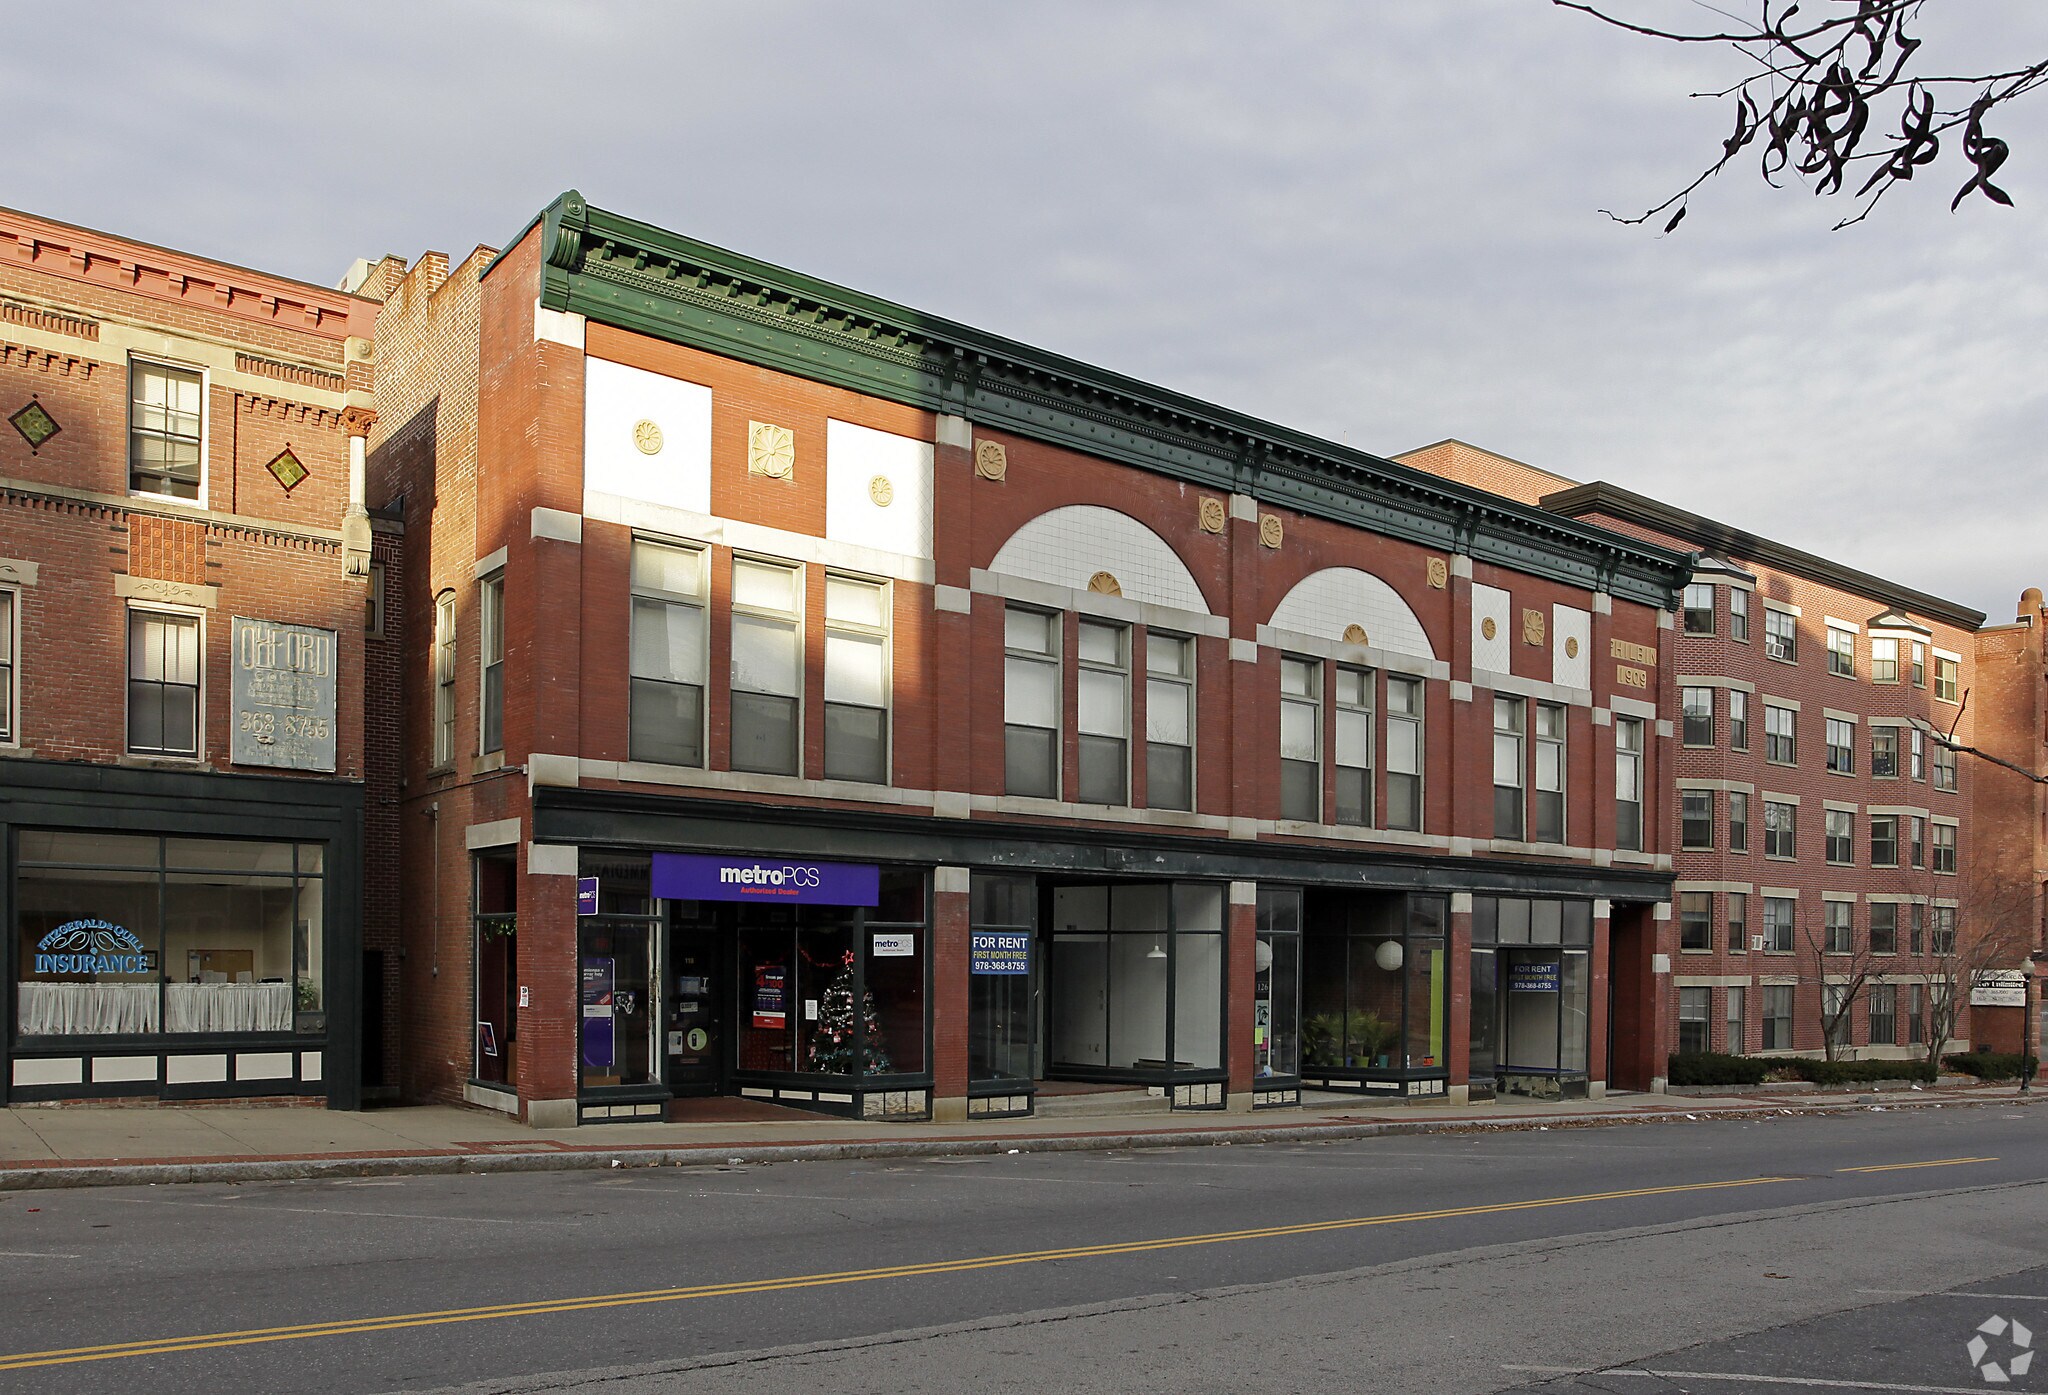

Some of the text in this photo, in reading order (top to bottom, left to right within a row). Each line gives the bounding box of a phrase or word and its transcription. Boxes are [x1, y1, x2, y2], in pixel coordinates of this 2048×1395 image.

[1619, 667, 1646, 687] 1909
[240, 710, 329, 739] 368-8755
[720, 865, 820, 887] metroPCS
[740, 887, 799, 896] Authorized Dealer
[37, 918, 107, 951] FITZGERALD
[113, 925, 144, 953] QUILL
[973, 936, 1028, 949] FOR RENT
[973, 950, 1027, 960] FIRST MONTH FREE
[35, 953, 148, 974] INSURANCE
[975, 961, 1025, 970] 978-368-8755
[1531, 965, 1552, 973] RENT
